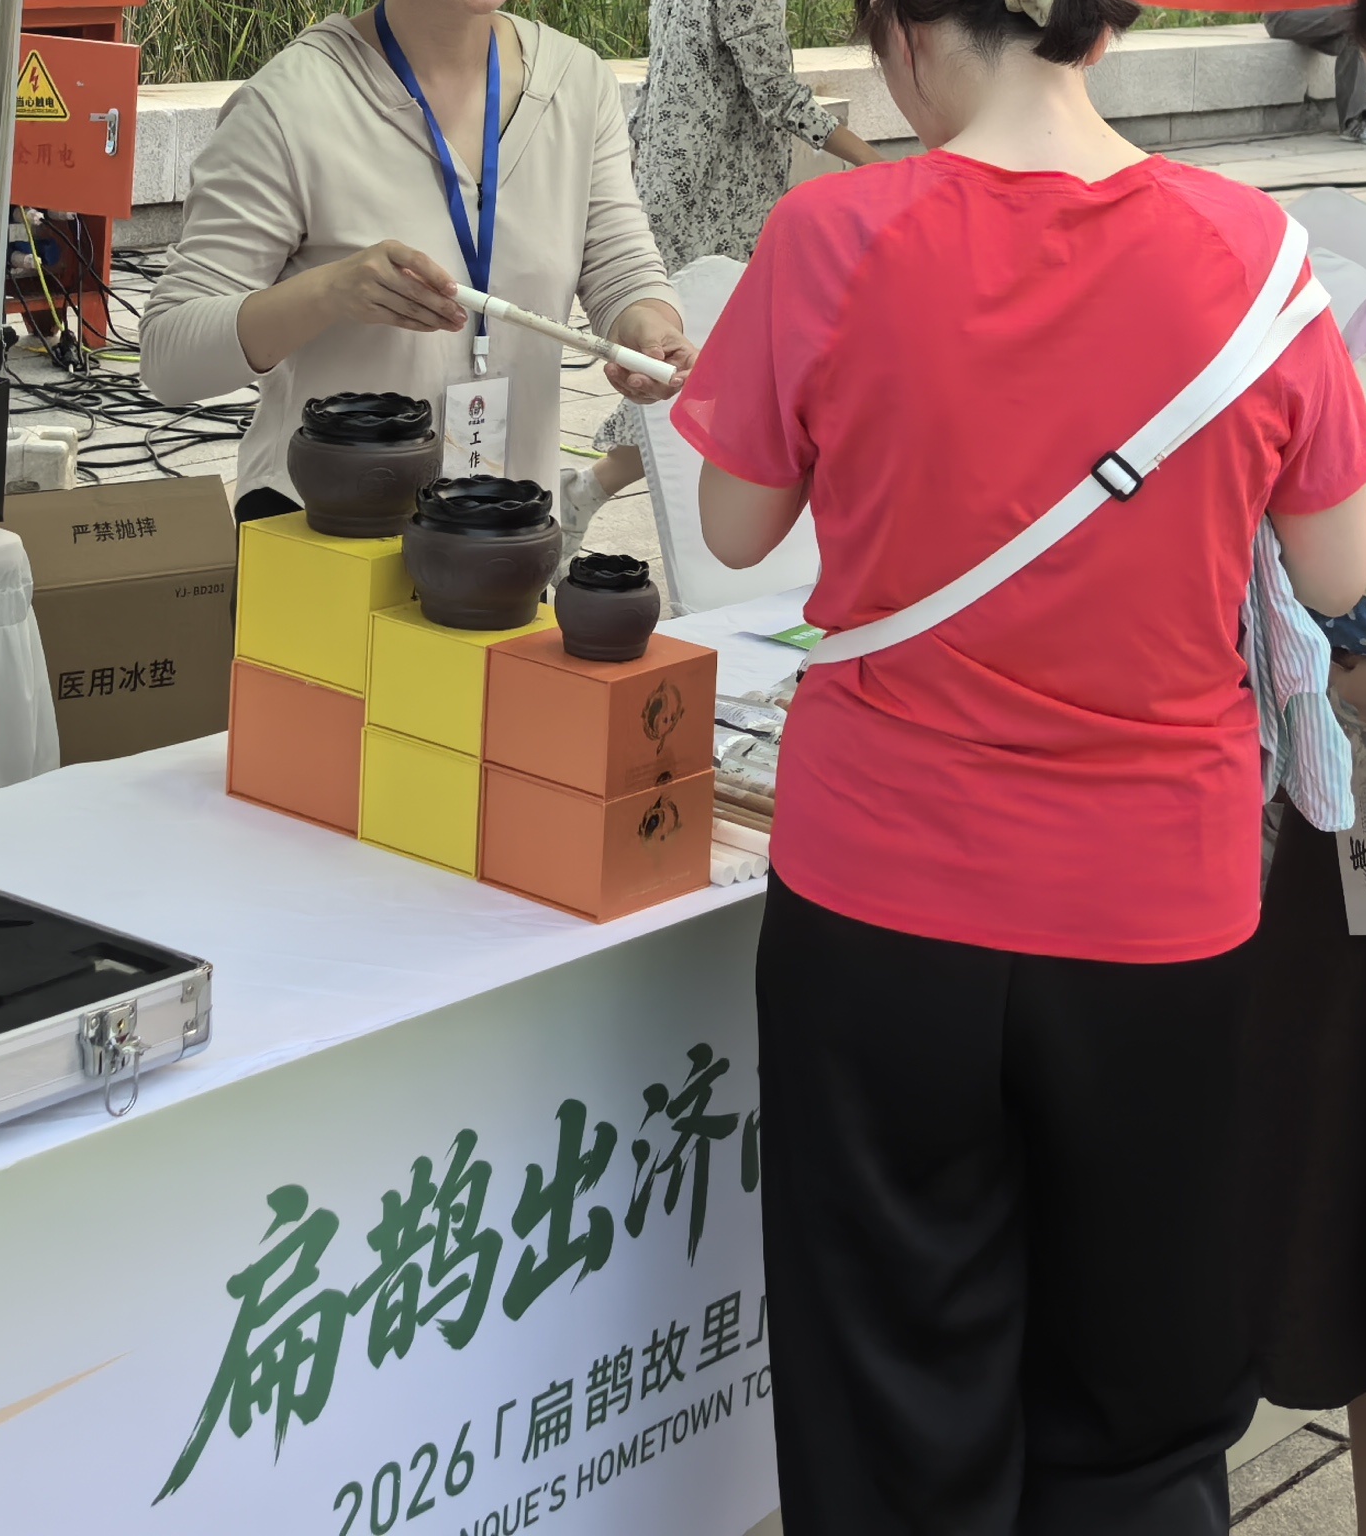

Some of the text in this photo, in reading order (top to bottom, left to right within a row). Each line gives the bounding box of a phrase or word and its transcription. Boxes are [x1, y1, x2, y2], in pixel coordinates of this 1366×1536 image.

[71, 516, 158, 544] 严禁抛摔
[58, 658, 177, 701] 医用冰垫
[150, 1041, 762, 1507] 扁鹊出济
[576, 1383, 734, 1500] HOMETOWN
